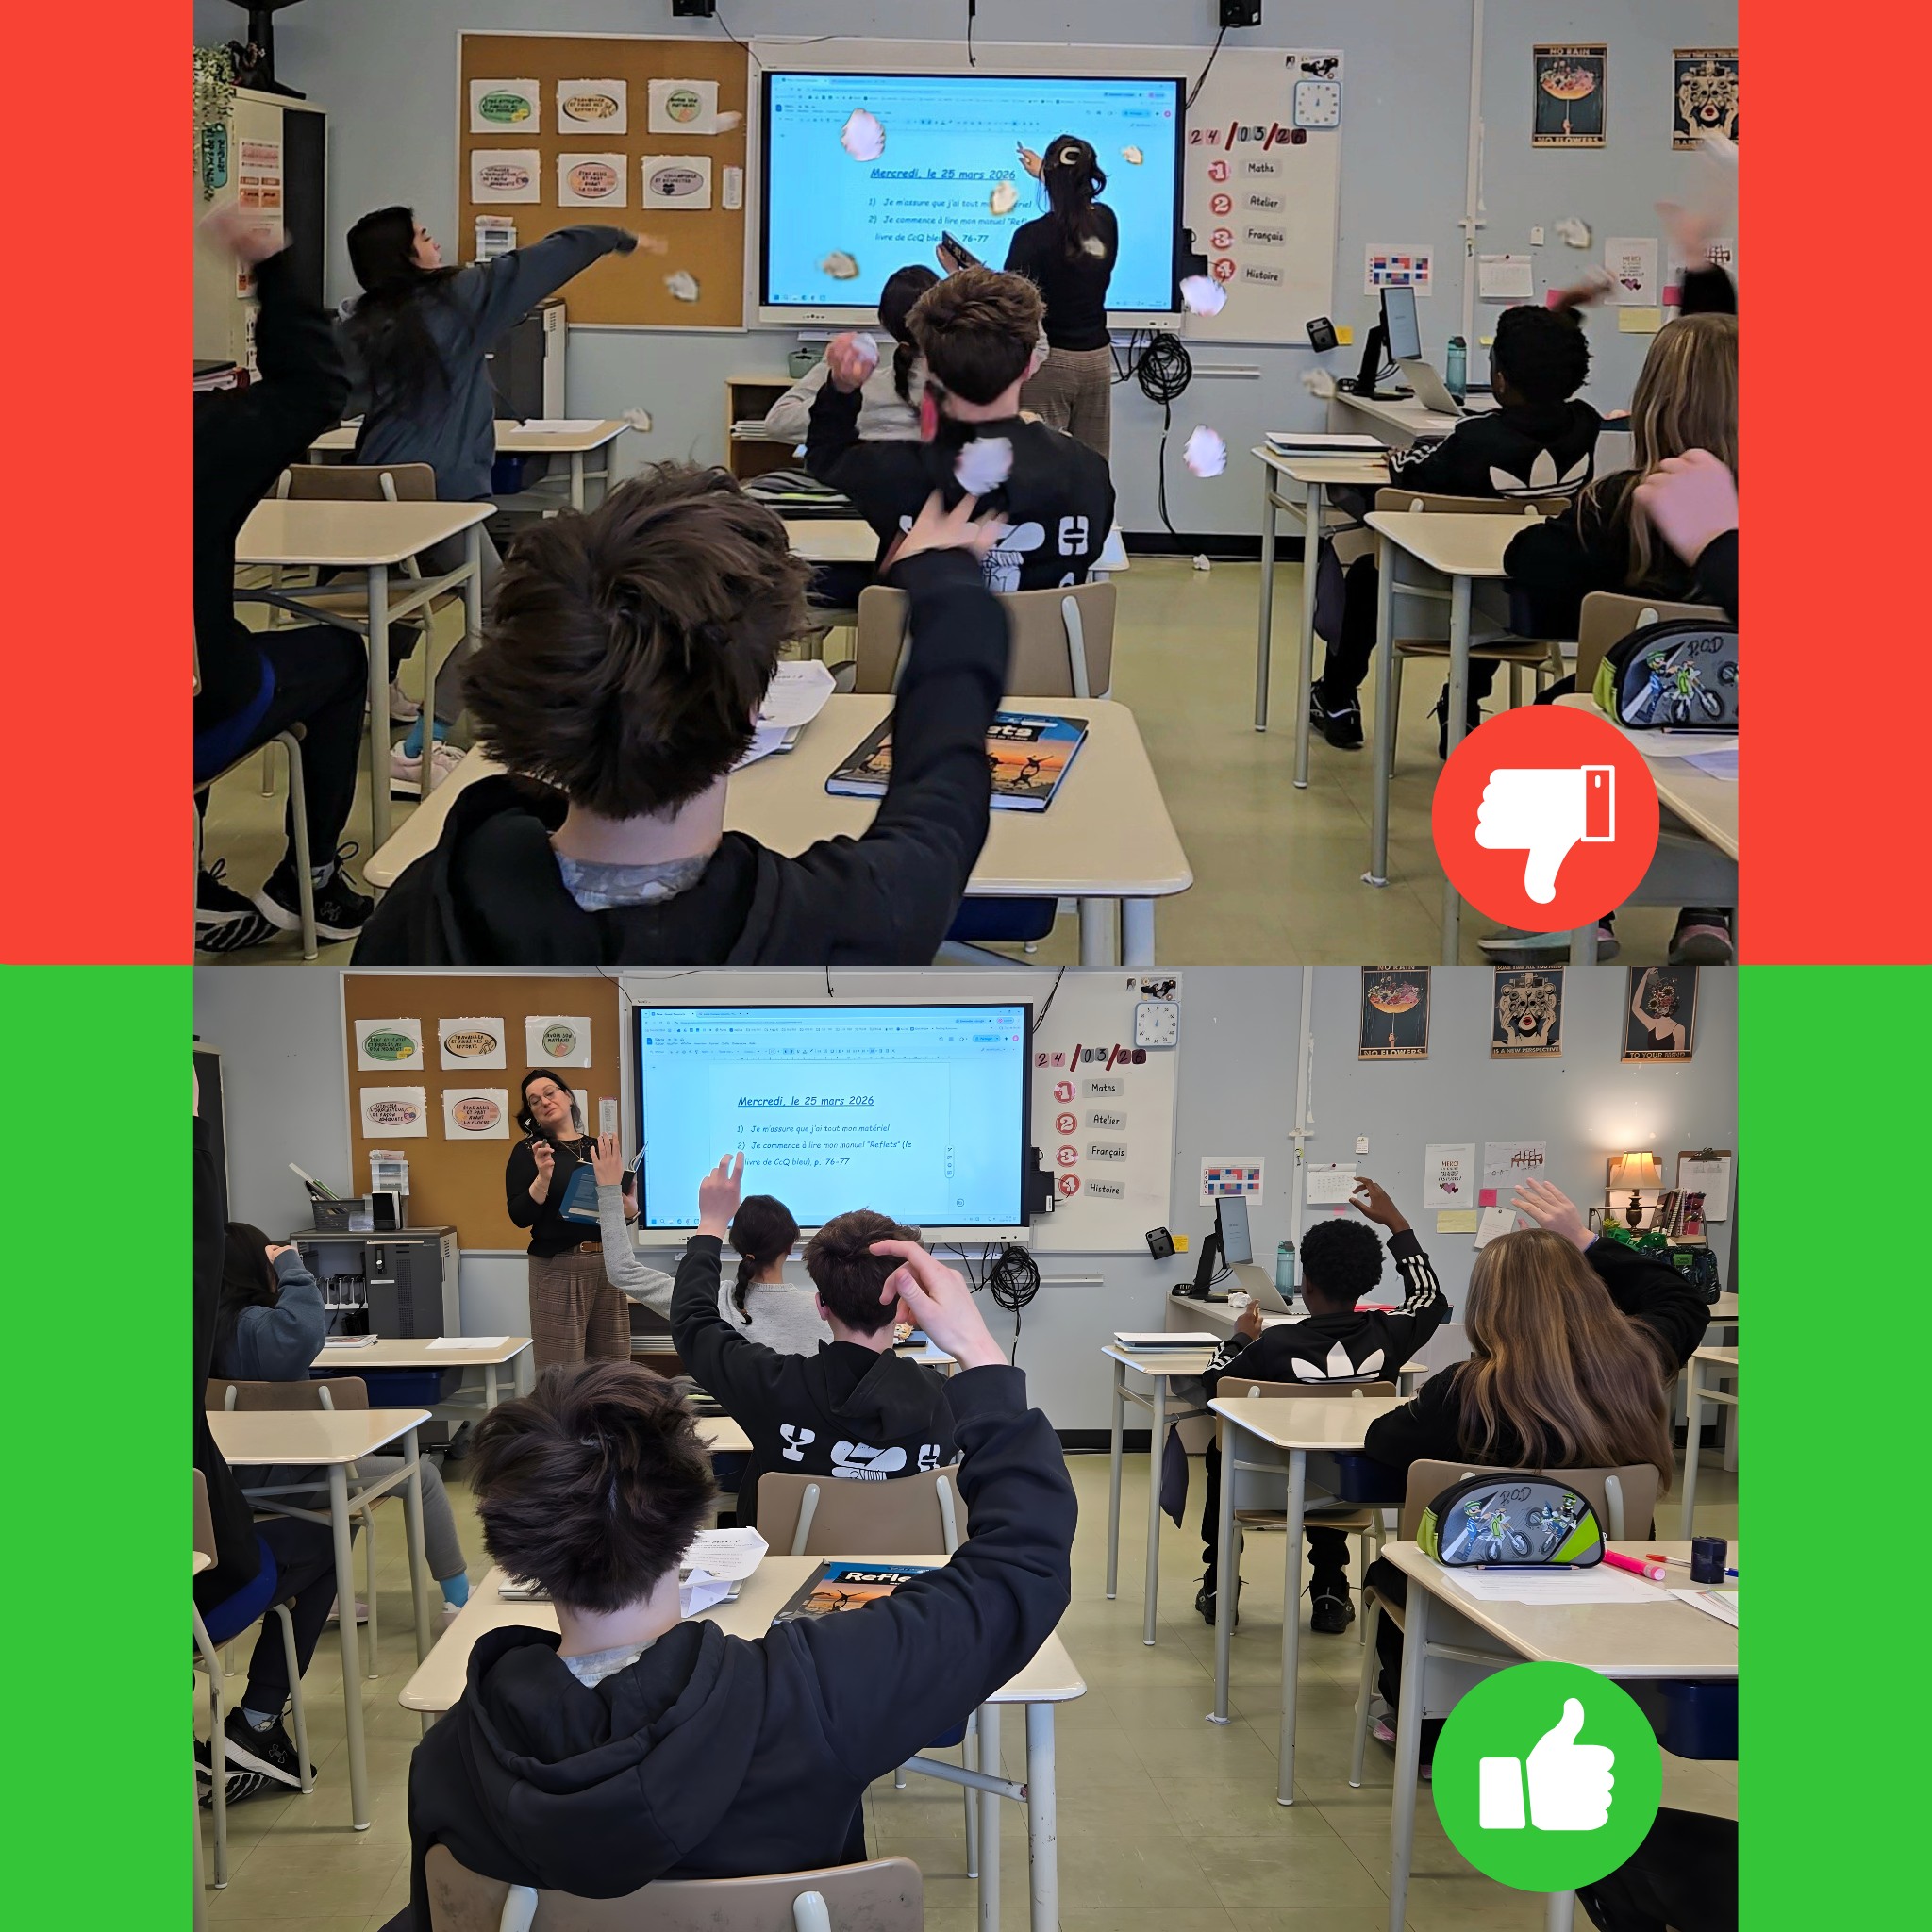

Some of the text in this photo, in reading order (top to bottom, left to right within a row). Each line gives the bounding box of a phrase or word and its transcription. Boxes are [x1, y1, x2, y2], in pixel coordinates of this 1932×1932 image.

[1248, 163, 1274, 173] Maths
[927, 168, 937, 178] le
[941, 169, 955, 179] 25
[958, 171, 984, 179] mars
[990, 170, 1016, 180] 2026
[883, 198, 894, 207] Je
[896, 198, 930, 207] m'assure
[947, 199, 959, 208] j'ai
[1250, 195, 1279, 208] Atelier
[868, 216, 877, 225] 2)
[944, 216, 958, 225] lire
[978, 217, 1006, 225] manuel
[961, 234, 989, 242] 76-77
[1248, 229, 1284, 242] Français
[1246, 269, 1278, 282] Histoire
[1091, 1083, 1116, 1092] Maths
[738, 1096, 786, 1107] Mercredi,
[791, 1095, 800, 1106] le
[804, 1096, 817, 1106] 25
[849, 1095, 874, 1106] 2026
[1093, 1114, 1121, 1125] Atelier
[737, 1125, 744, 1134] 1)
[809, 1124, 823, 1134] j'ai
[858, 1124, 891, 1132] matériel
[737, 1141, 745, 1151] 2)
[808, 1141, 822, 1149] lire
[867, 1141, 901, 1149] "Reflets"
[902, 1140, 912, 1149] (le
[1091, 1146, 1124, 1158] Français
[824, 1158, 851, 1166] 76-77
[1090, 1183, 1120, 1195] Histoire
[845, 1572, 912, 1583] Refle
